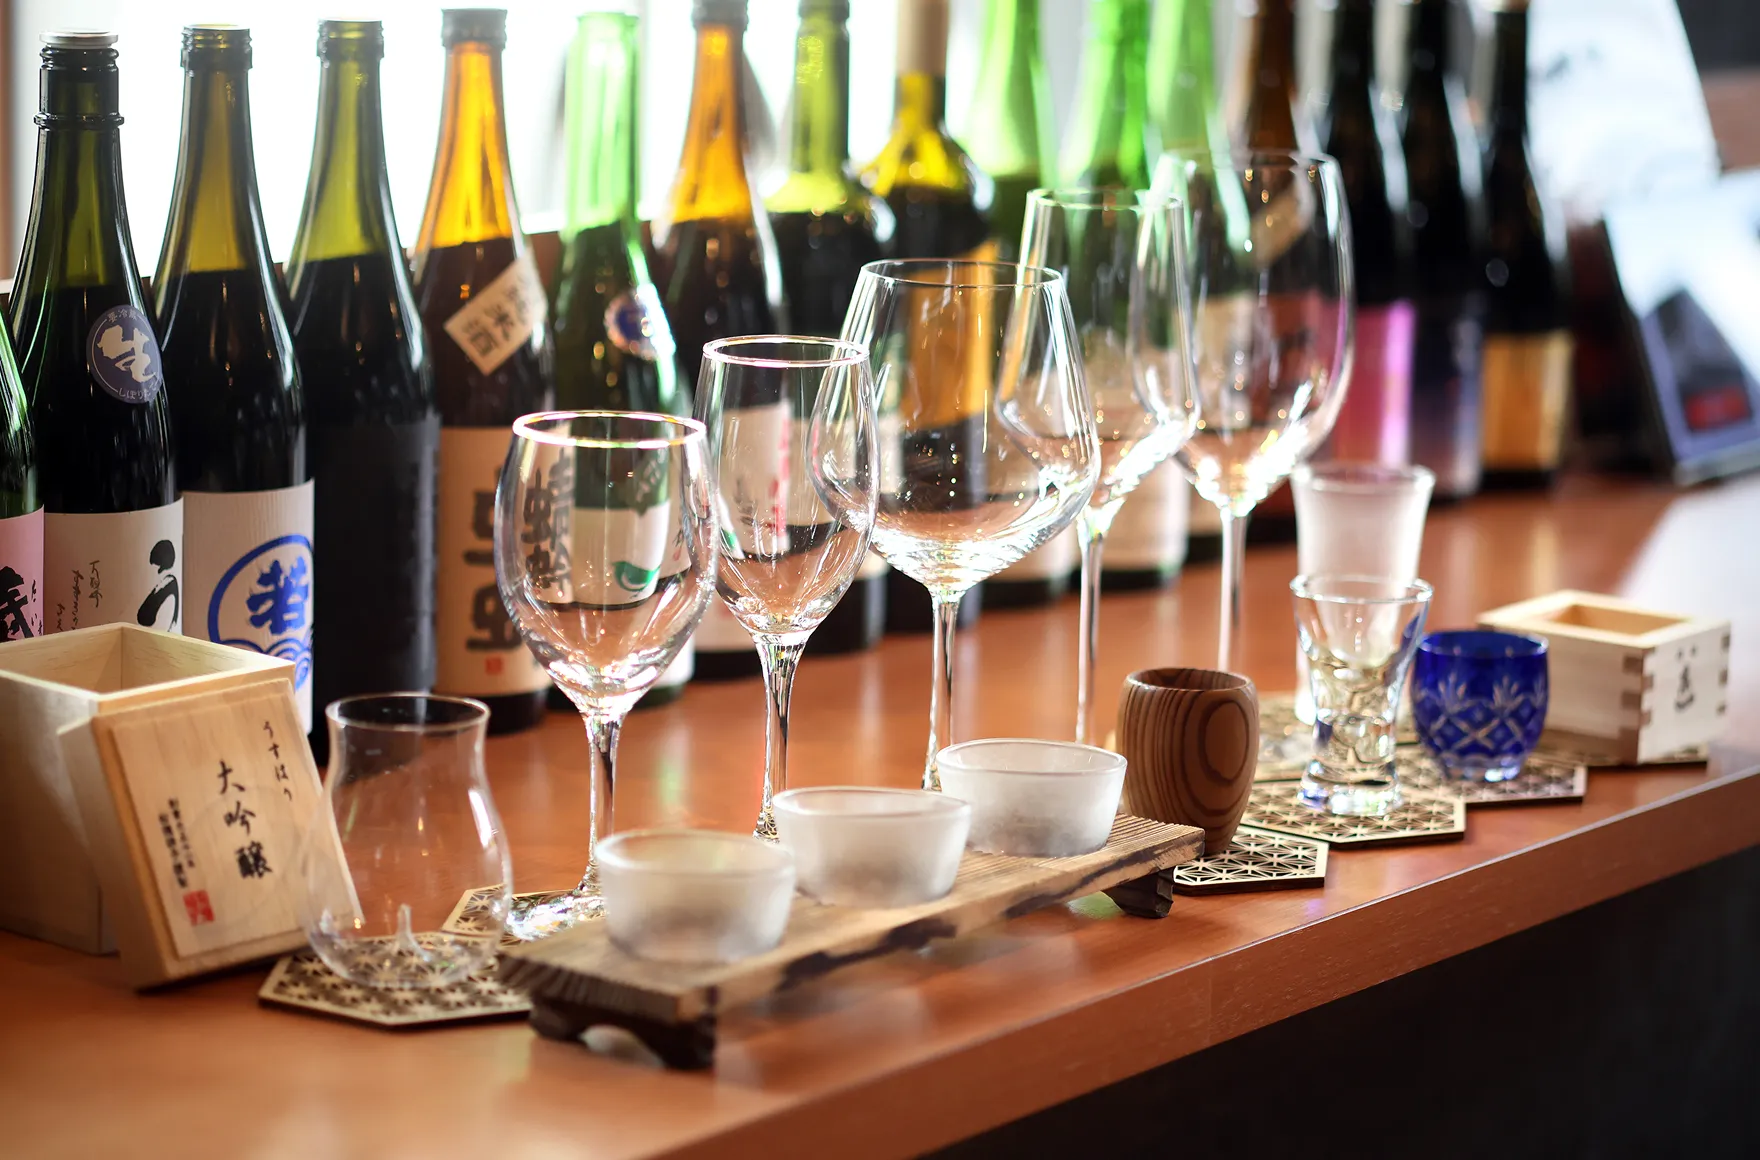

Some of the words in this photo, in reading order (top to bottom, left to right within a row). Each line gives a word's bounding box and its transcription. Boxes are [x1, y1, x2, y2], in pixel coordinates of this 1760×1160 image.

[246, 555, 310, 637] 若
[263, 720, 294, 803] うすはり
[216, 759, 273, 880] 大吟醸
